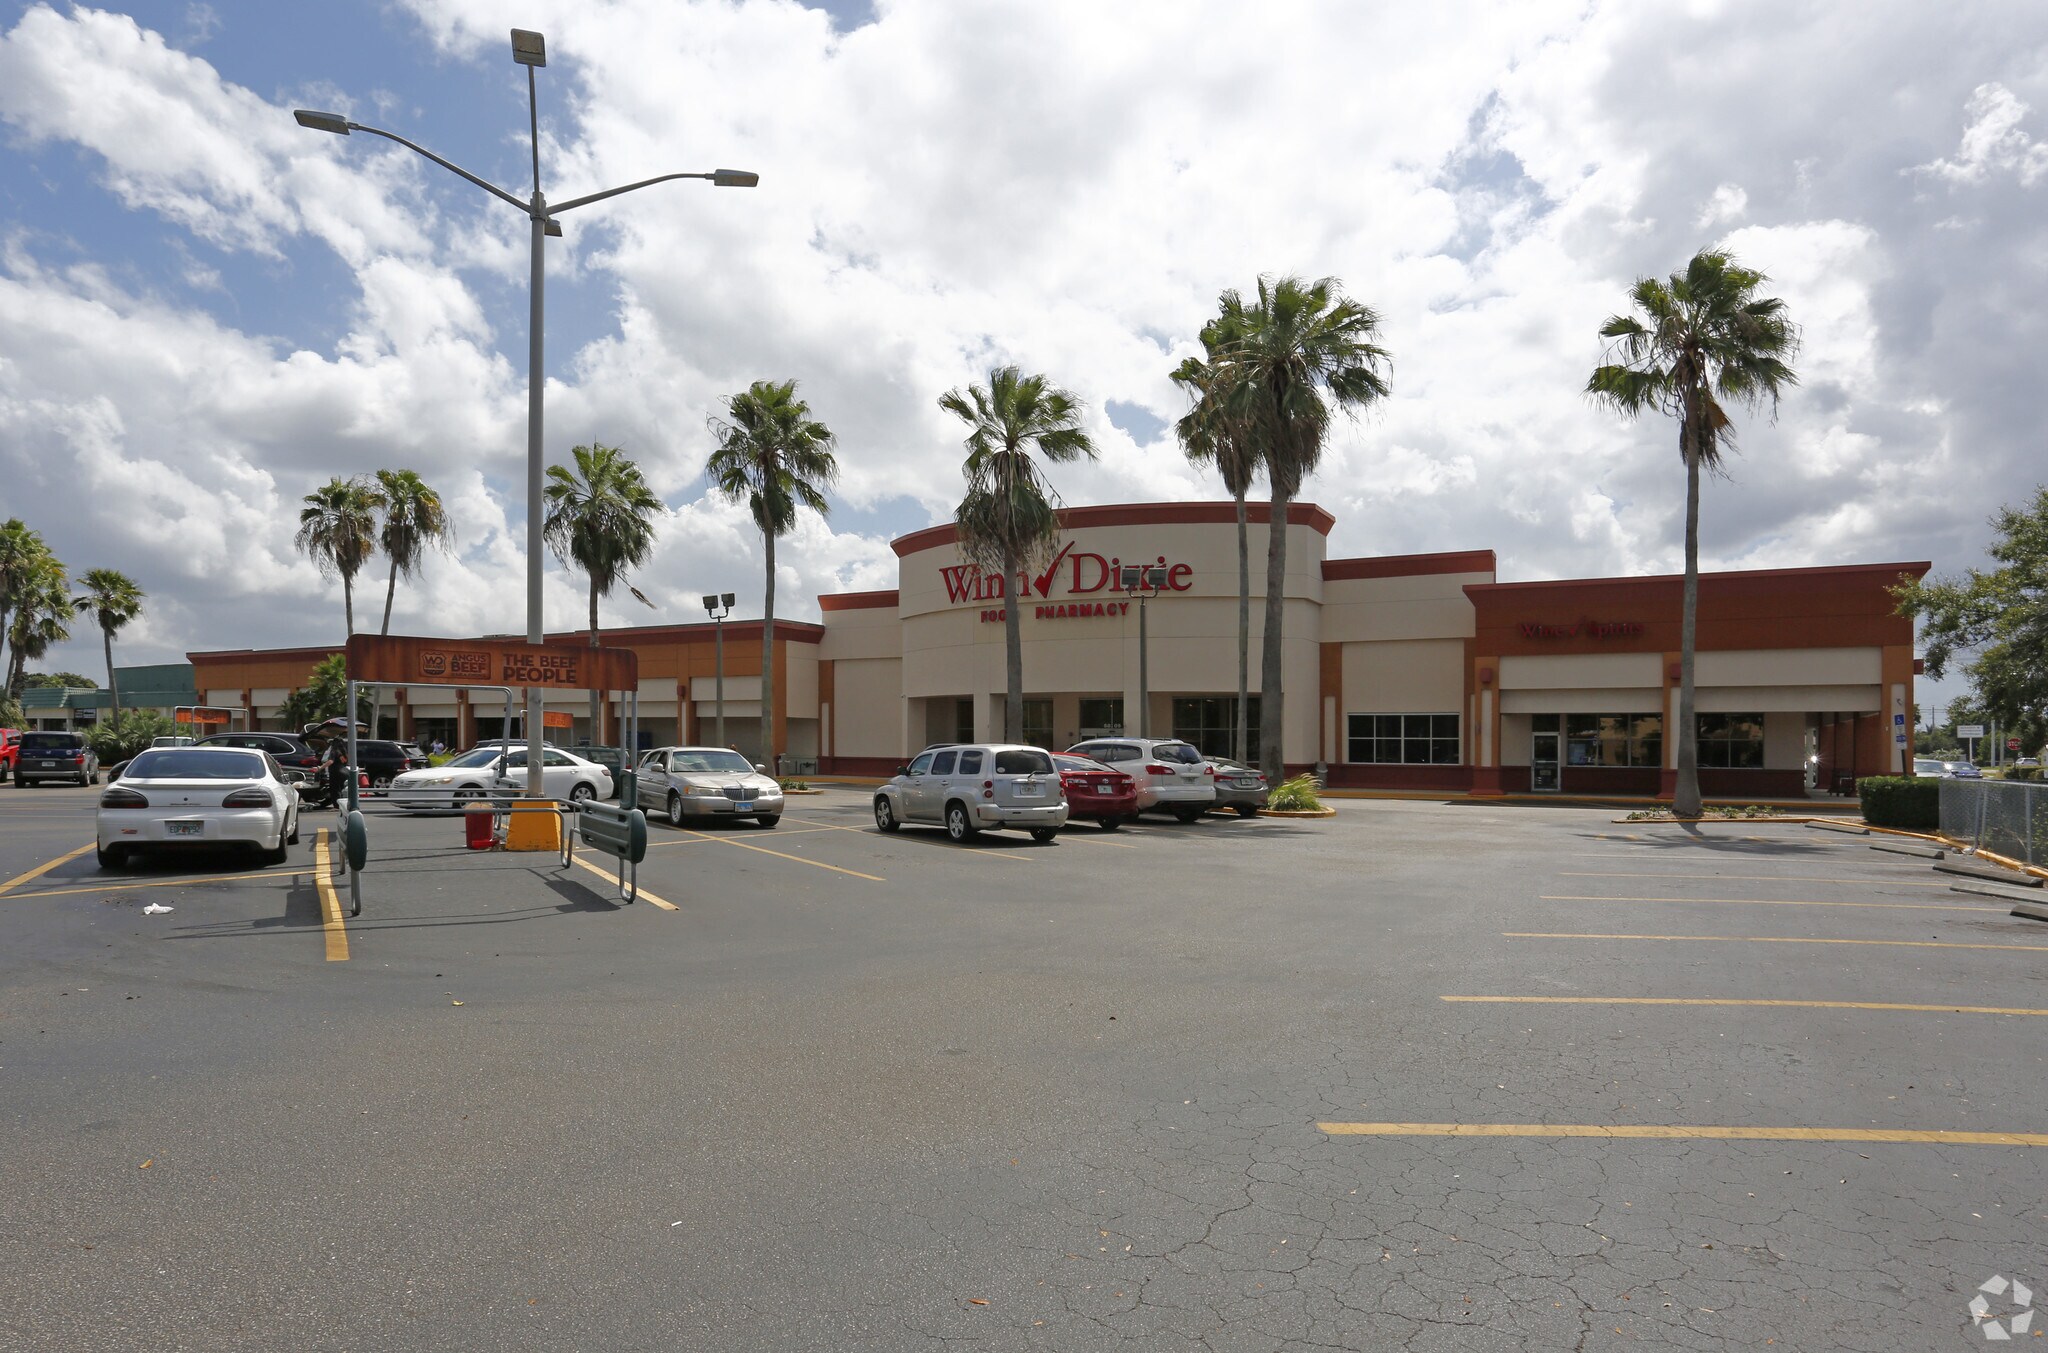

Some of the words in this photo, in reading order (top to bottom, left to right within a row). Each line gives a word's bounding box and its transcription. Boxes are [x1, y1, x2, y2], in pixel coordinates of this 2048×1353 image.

[939, 564, 1032, 604] Winn
[980, 609, 1007, 624] FOO
[1036, 602, 1130, 620] PHARMACY
[451, 654, 487, 662] ANGUS
[503, 654, 534, 666] THE
[540, 655, 578, 669] BEEF
[451, 661, 487, 673] BEEF
[503, 666, 577, 683] PEOPLE
